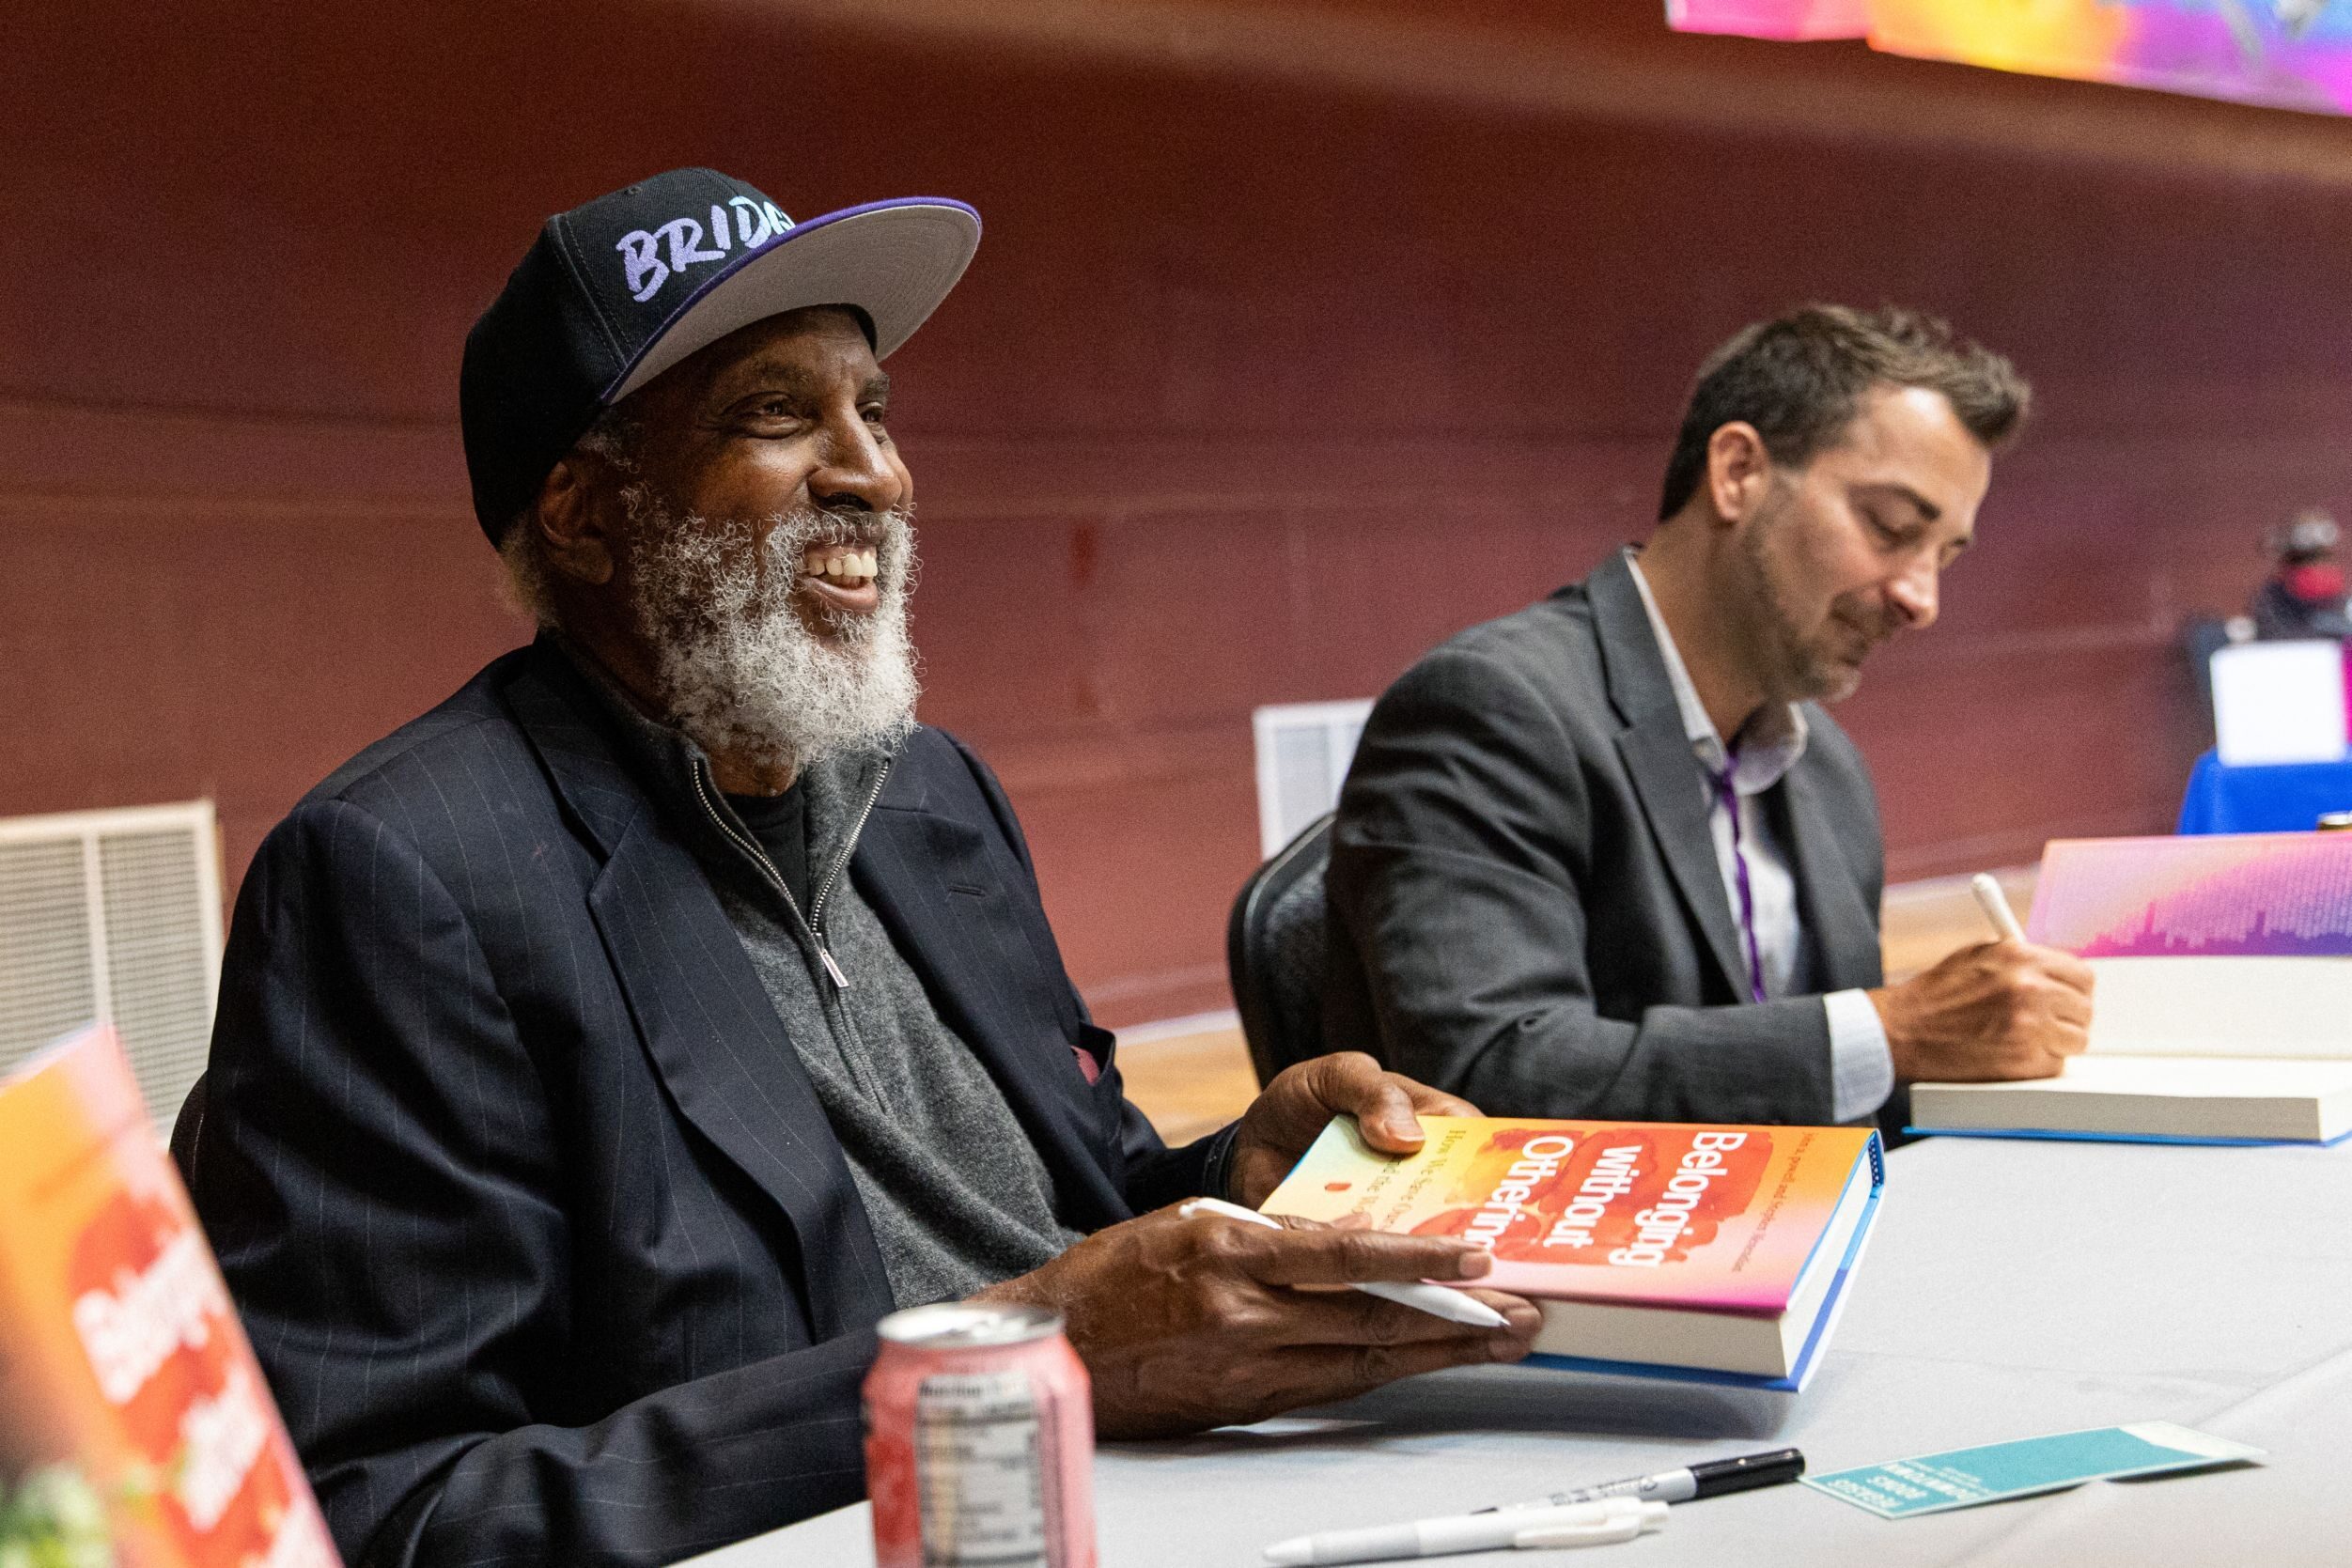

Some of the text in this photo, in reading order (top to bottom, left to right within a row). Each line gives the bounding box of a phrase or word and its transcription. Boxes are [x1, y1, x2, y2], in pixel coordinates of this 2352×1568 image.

[1464, 1136, 1574, 1250] Otherin
[1543, 1145, 1643, 1249] without
[1608, 1132, 1748, 1267] Belonging
